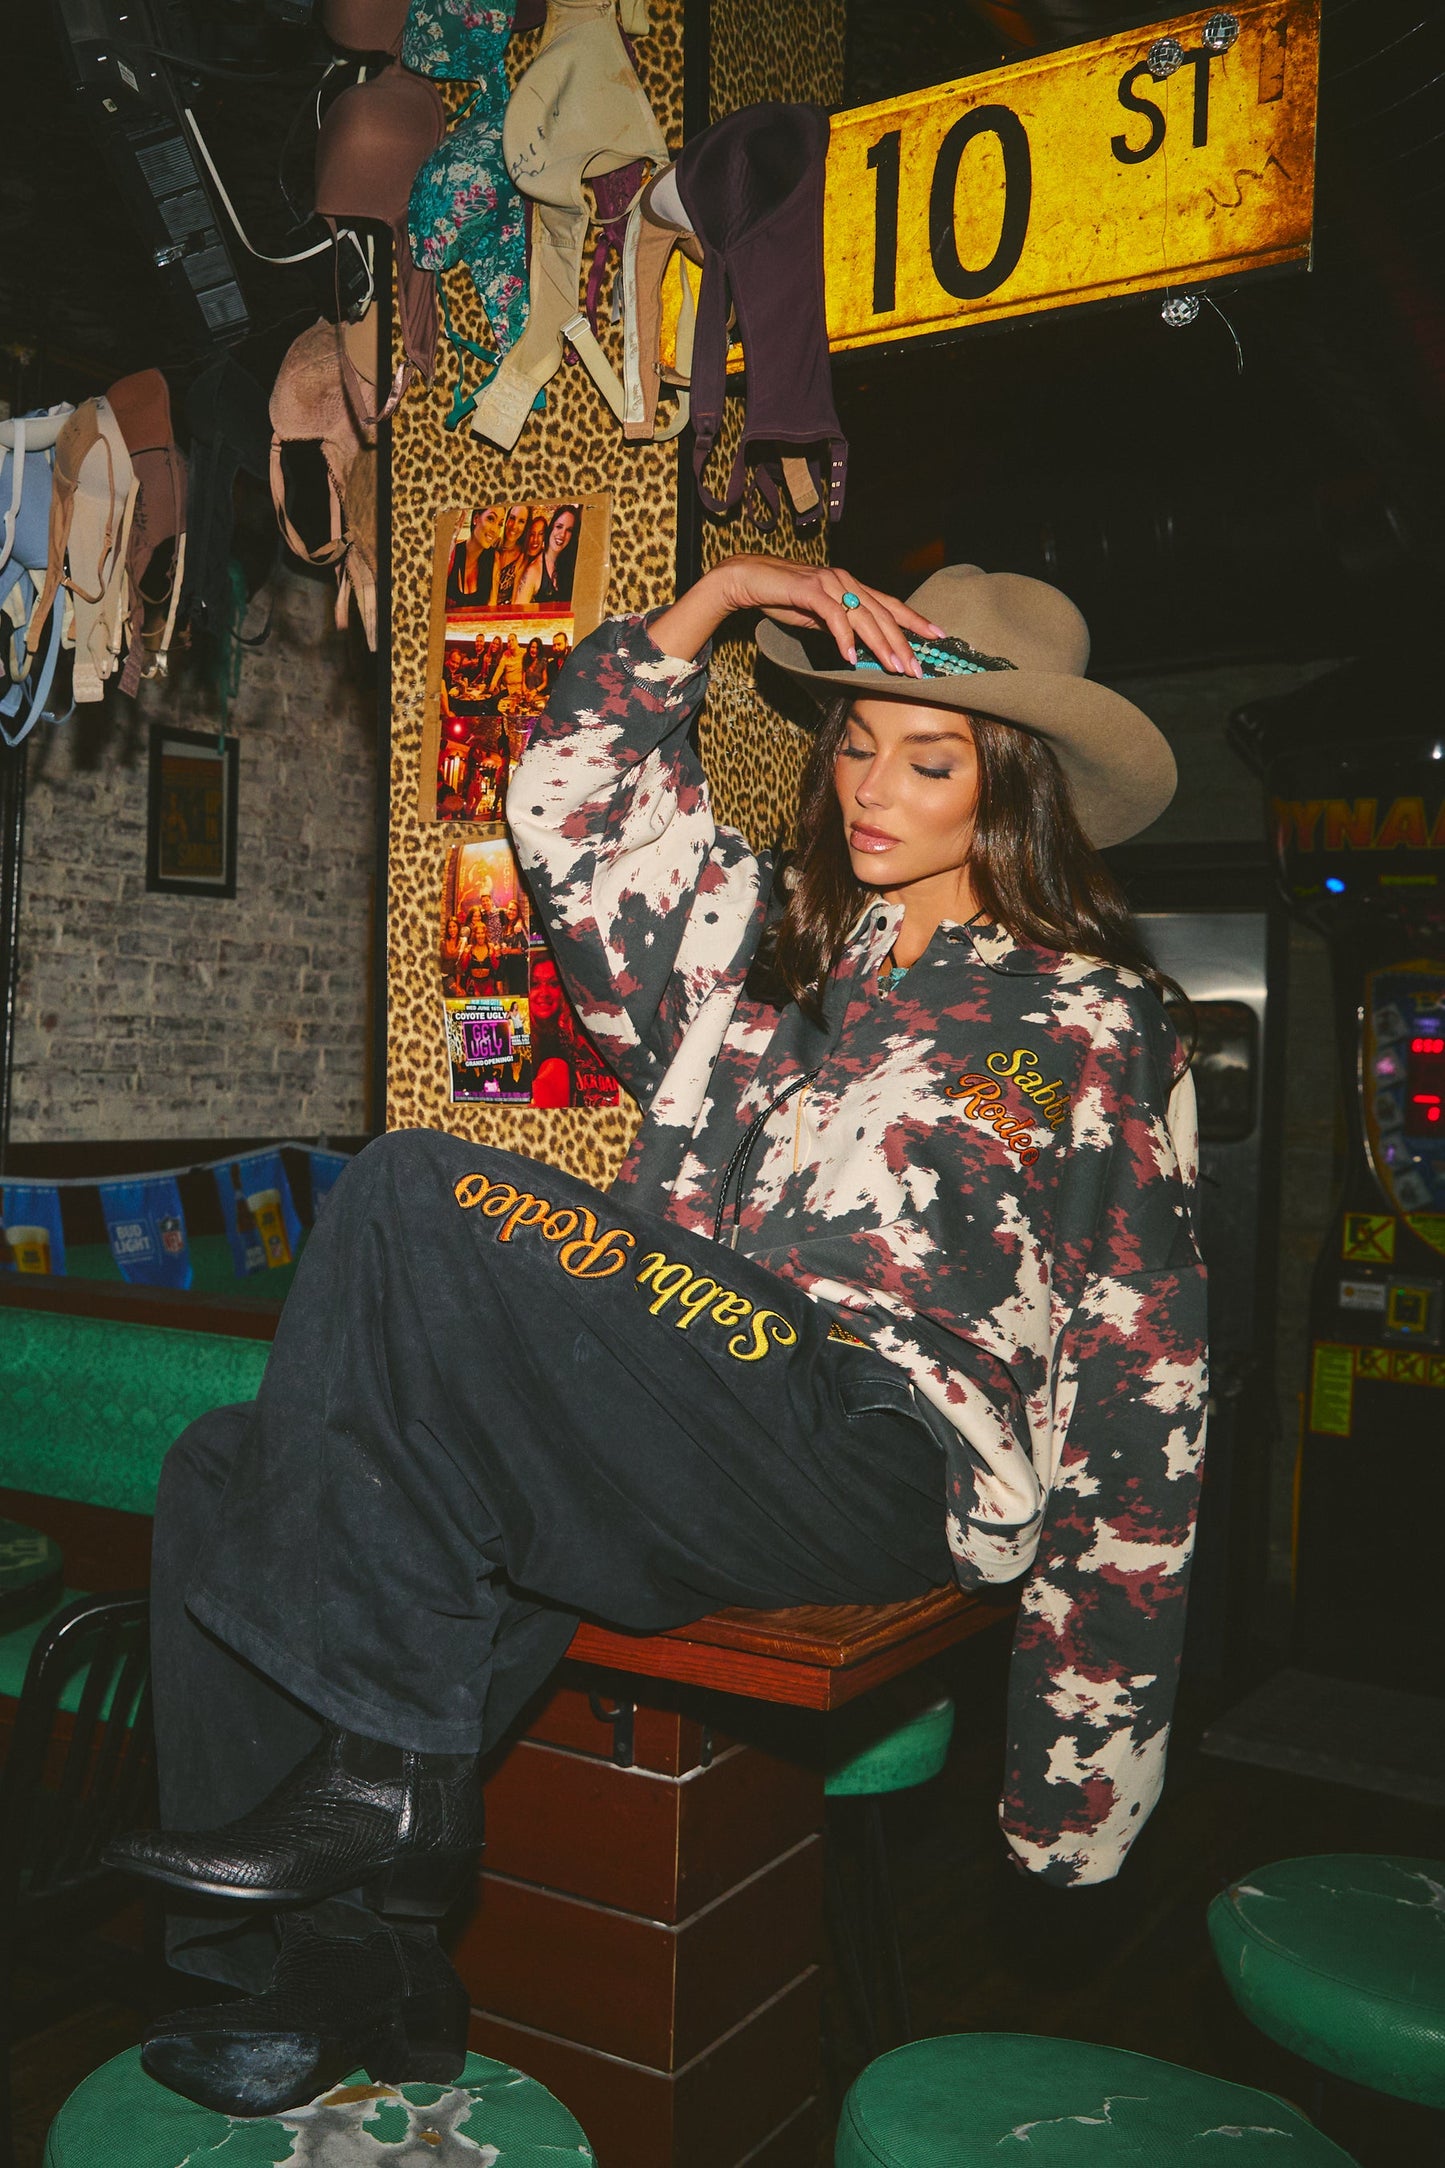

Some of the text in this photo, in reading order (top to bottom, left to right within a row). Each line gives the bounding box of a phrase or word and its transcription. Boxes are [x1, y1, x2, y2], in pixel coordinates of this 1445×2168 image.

[866, 104, 1032, 315] 10
[1111, 46, 1228, 164] ST
[455, 1011, 508, 1020] COYOTE UGLY
[472, 1023, 498, 1041] GET
[471, 1038, 502, 1057] UGLY
[986, 1048, 1073, 1131] Sabbi
[944, 1073, 1040, 1167] Rodeo
[116, 1224, 142, 1240] BUD
[114, 1236, 150, 1254] LIGHT
[453, 1172, 799, 1363] Sabbi Rodeo
